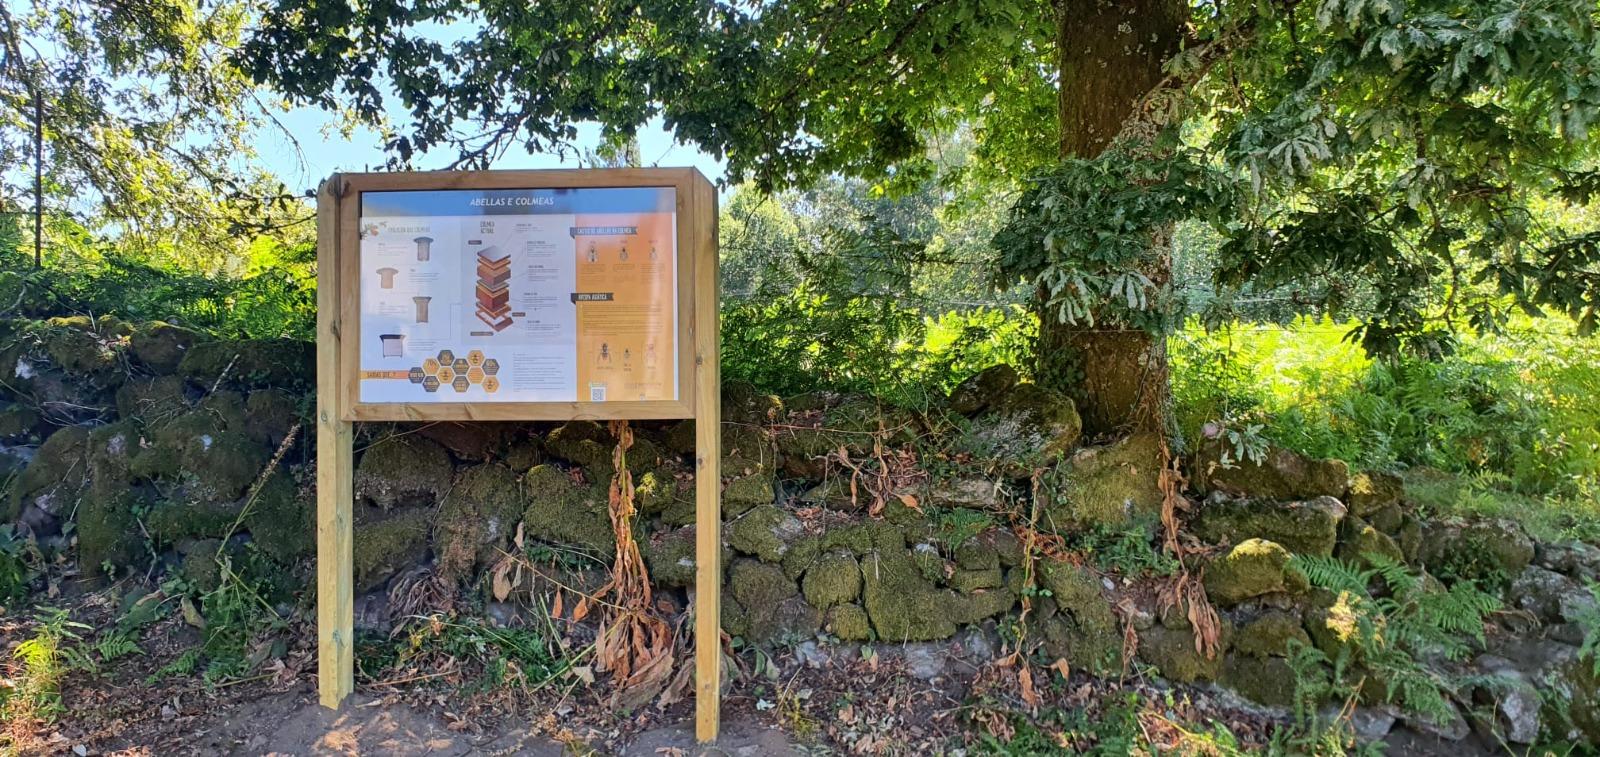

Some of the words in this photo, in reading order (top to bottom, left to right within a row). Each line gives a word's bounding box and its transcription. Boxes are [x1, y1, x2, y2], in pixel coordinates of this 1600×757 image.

[470, 198, 505, 206] ABELLAS
[507, 198, 513, 206] E
[515, 197, 554, 206] COLMEAS
